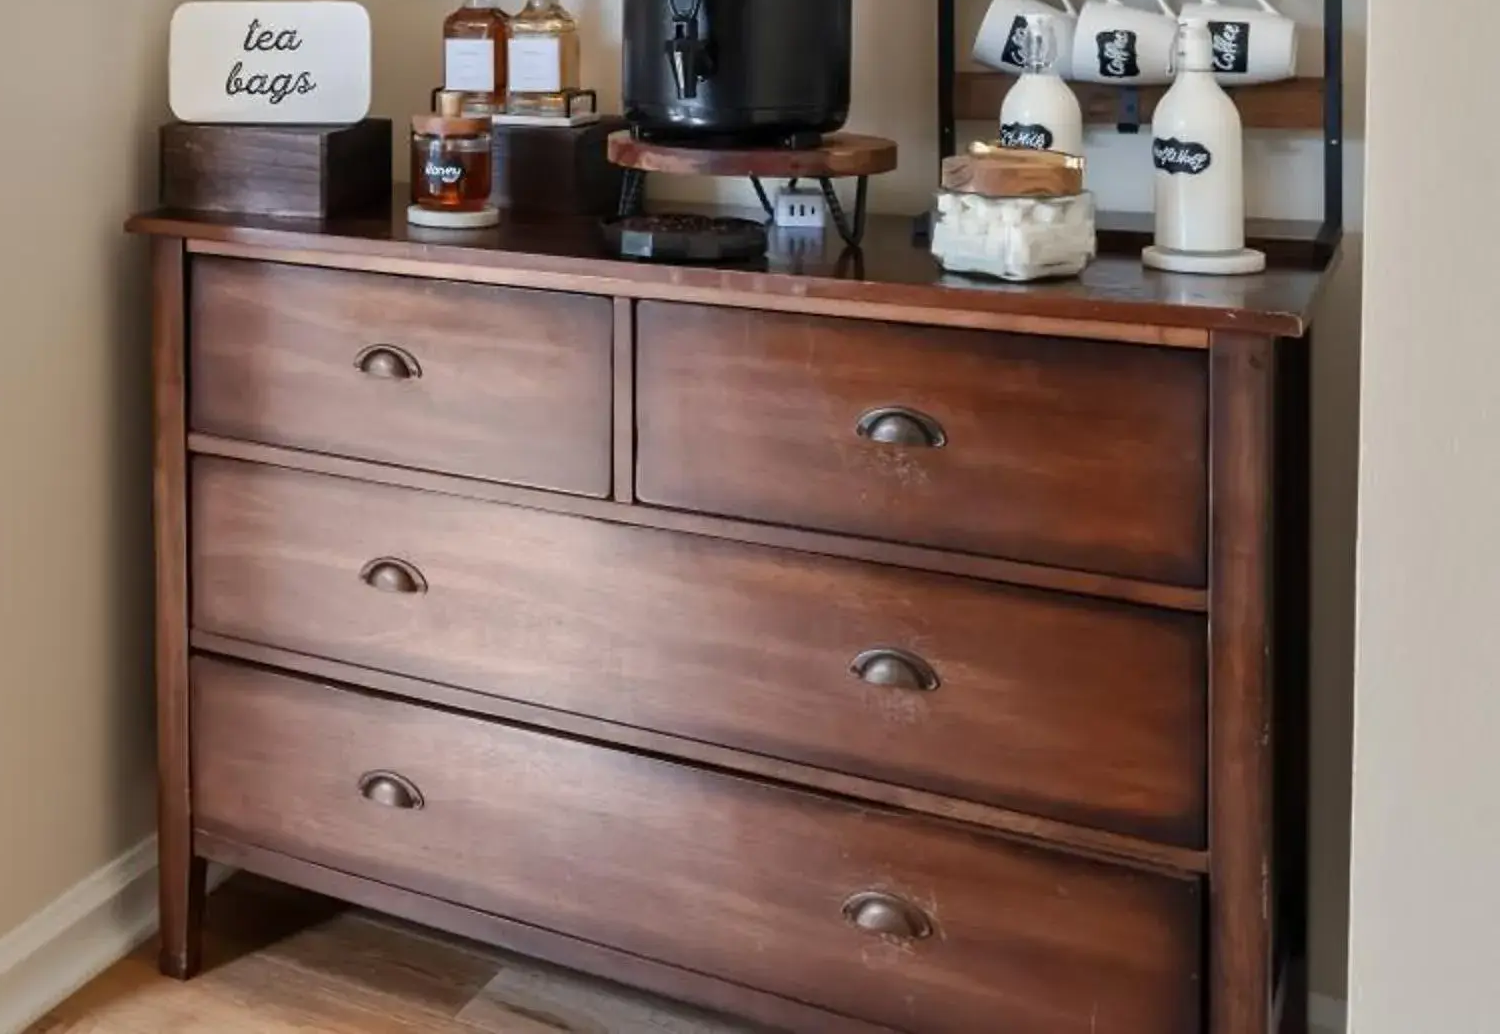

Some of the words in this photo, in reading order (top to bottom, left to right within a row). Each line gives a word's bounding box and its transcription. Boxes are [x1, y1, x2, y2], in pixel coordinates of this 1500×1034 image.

[243, 18, 303, 51] tea
[1104, 31, 1129, 74] Coffee
[1212, 23, 1240, 70] Coffee
[225, 61, 317, 105] bags
